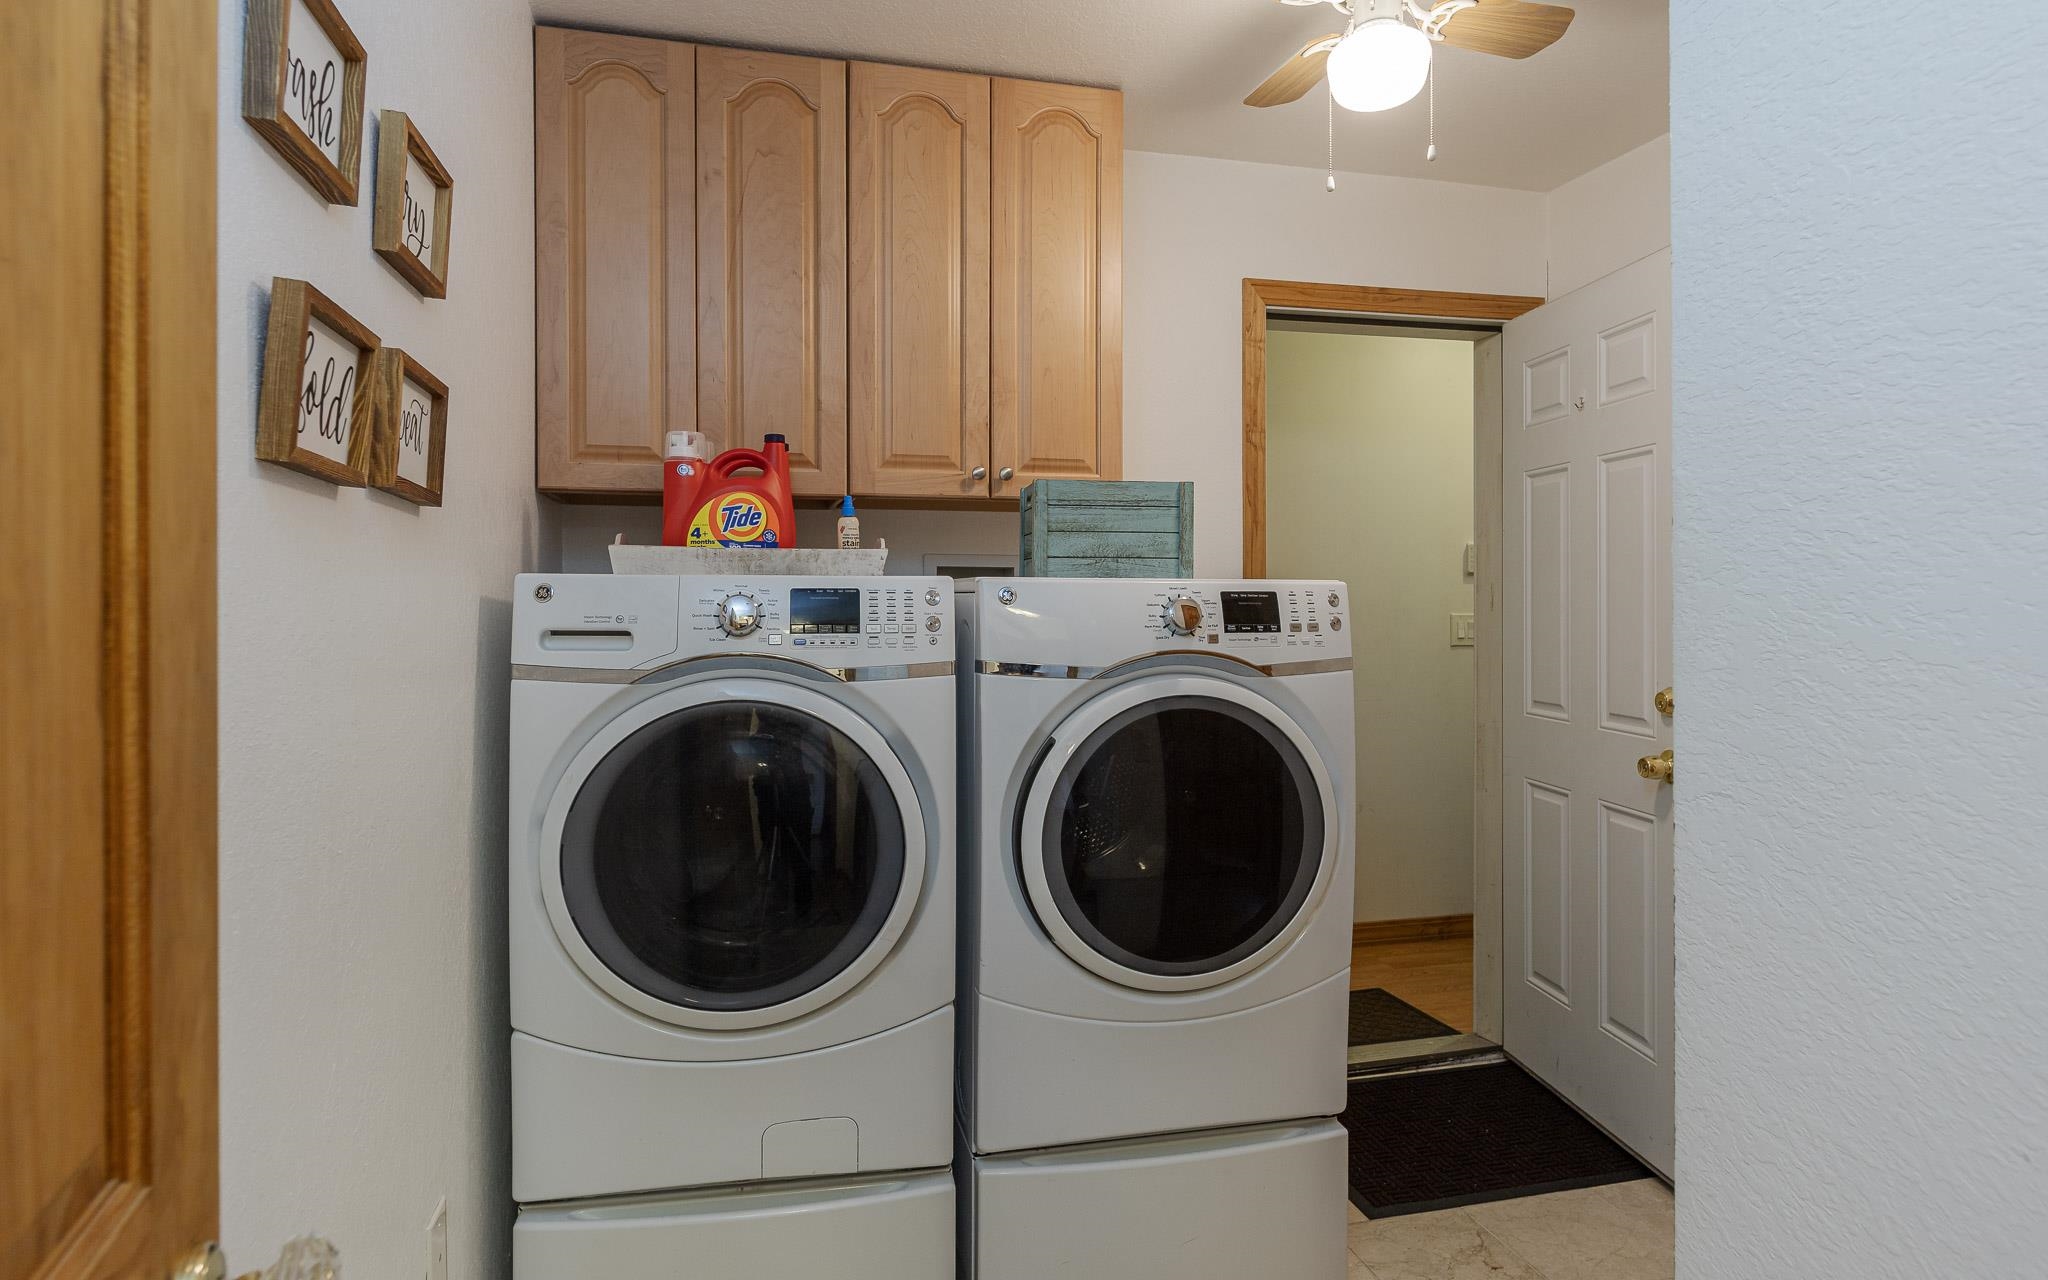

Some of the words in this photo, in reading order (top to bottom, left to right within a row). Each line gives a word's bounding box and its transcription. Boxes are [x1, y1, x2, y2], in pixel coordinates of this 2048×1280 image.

[287, 47, 336, 148] ash
[402, 179, 430, 258] ry
[720, 503, 763, 534] Tide
